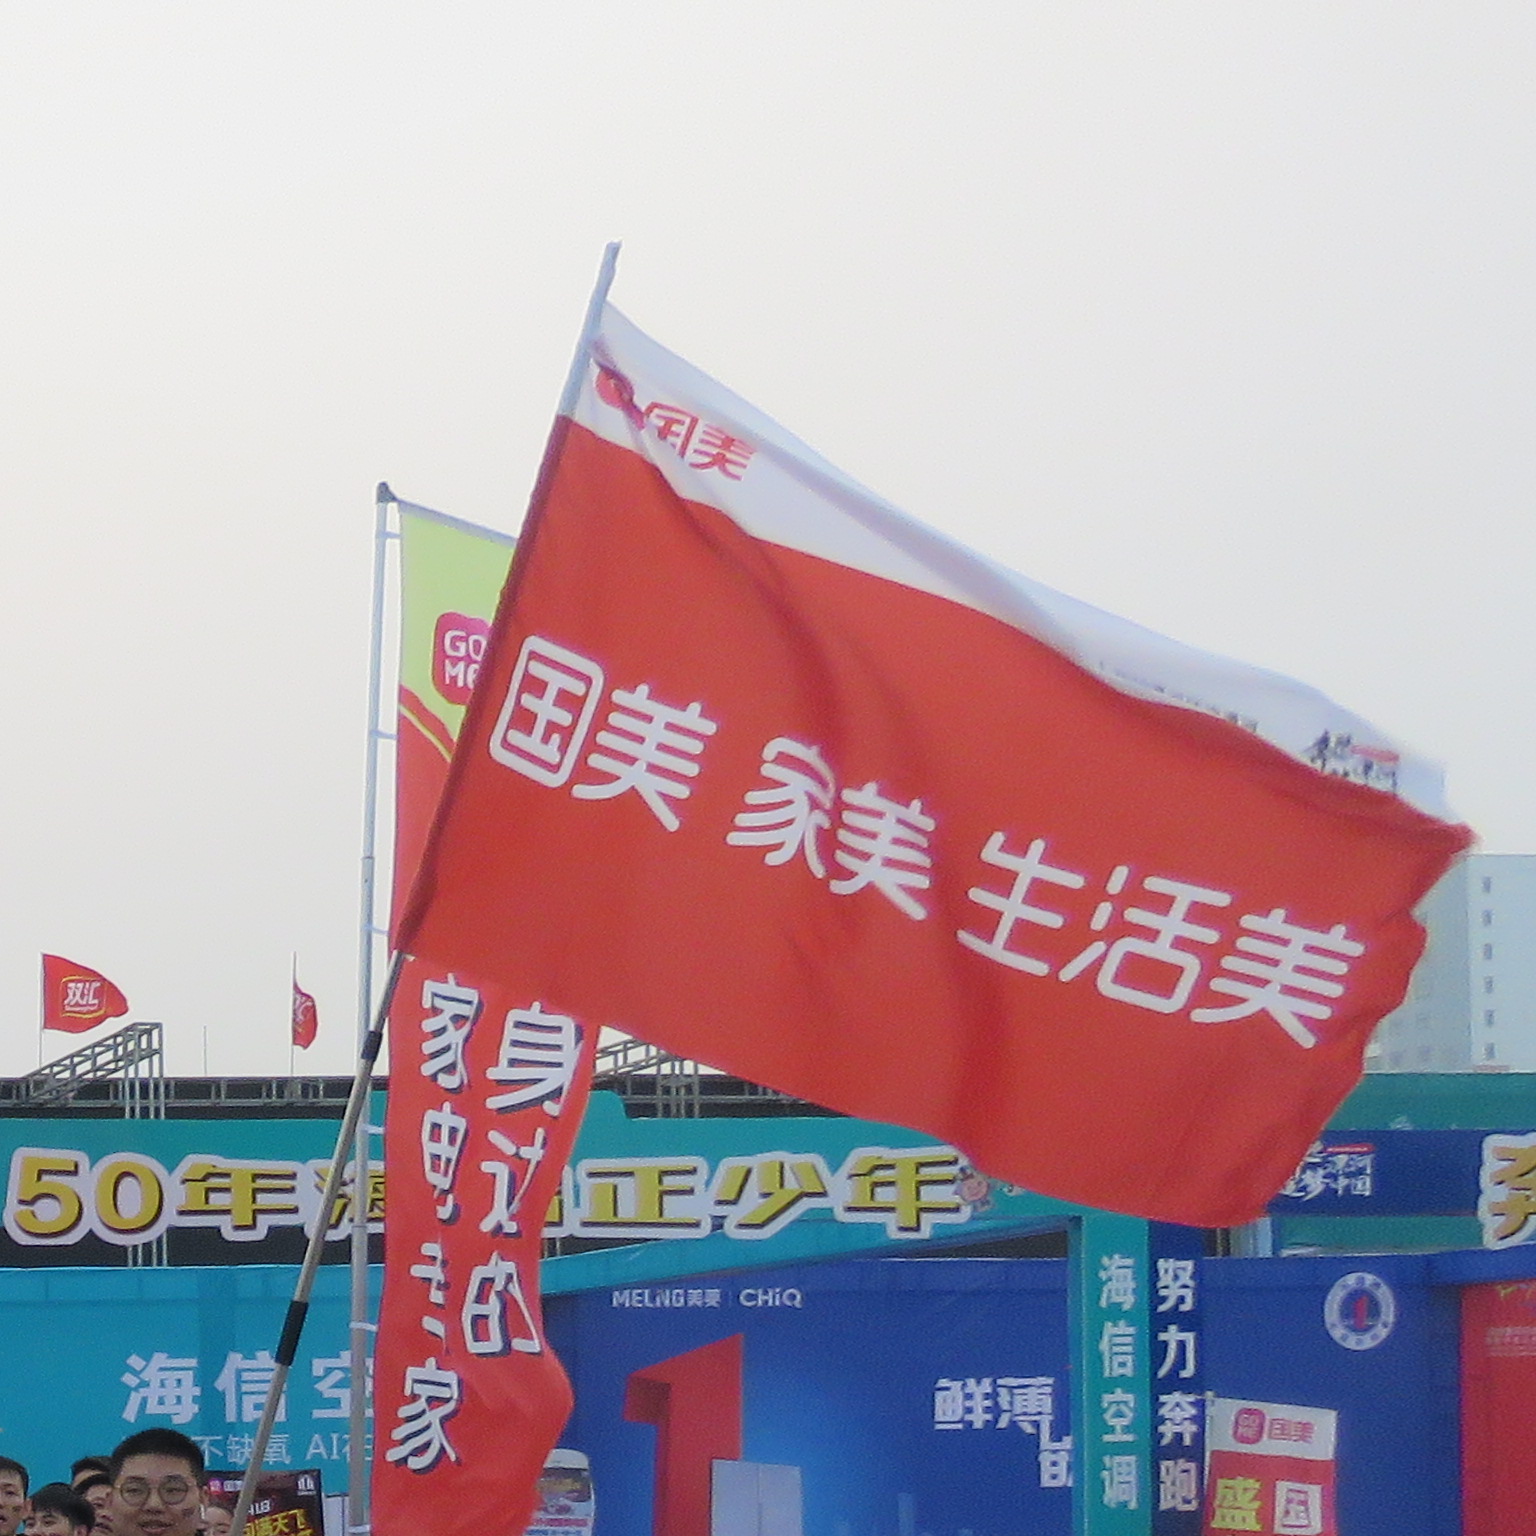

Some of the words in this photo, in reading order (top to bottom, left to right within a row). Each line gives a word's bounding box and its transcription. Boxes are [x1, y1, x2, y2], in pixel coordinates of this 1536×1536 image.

[488, 633, 719, 831] 国美
[726, 733, 937, 920] 家美
[956, 829, 1366, 1051] 生活美
[1097, 1253, 1140, 1511] 海信空调
[1155, 1257, 1200, 1513] 努力奔跑
